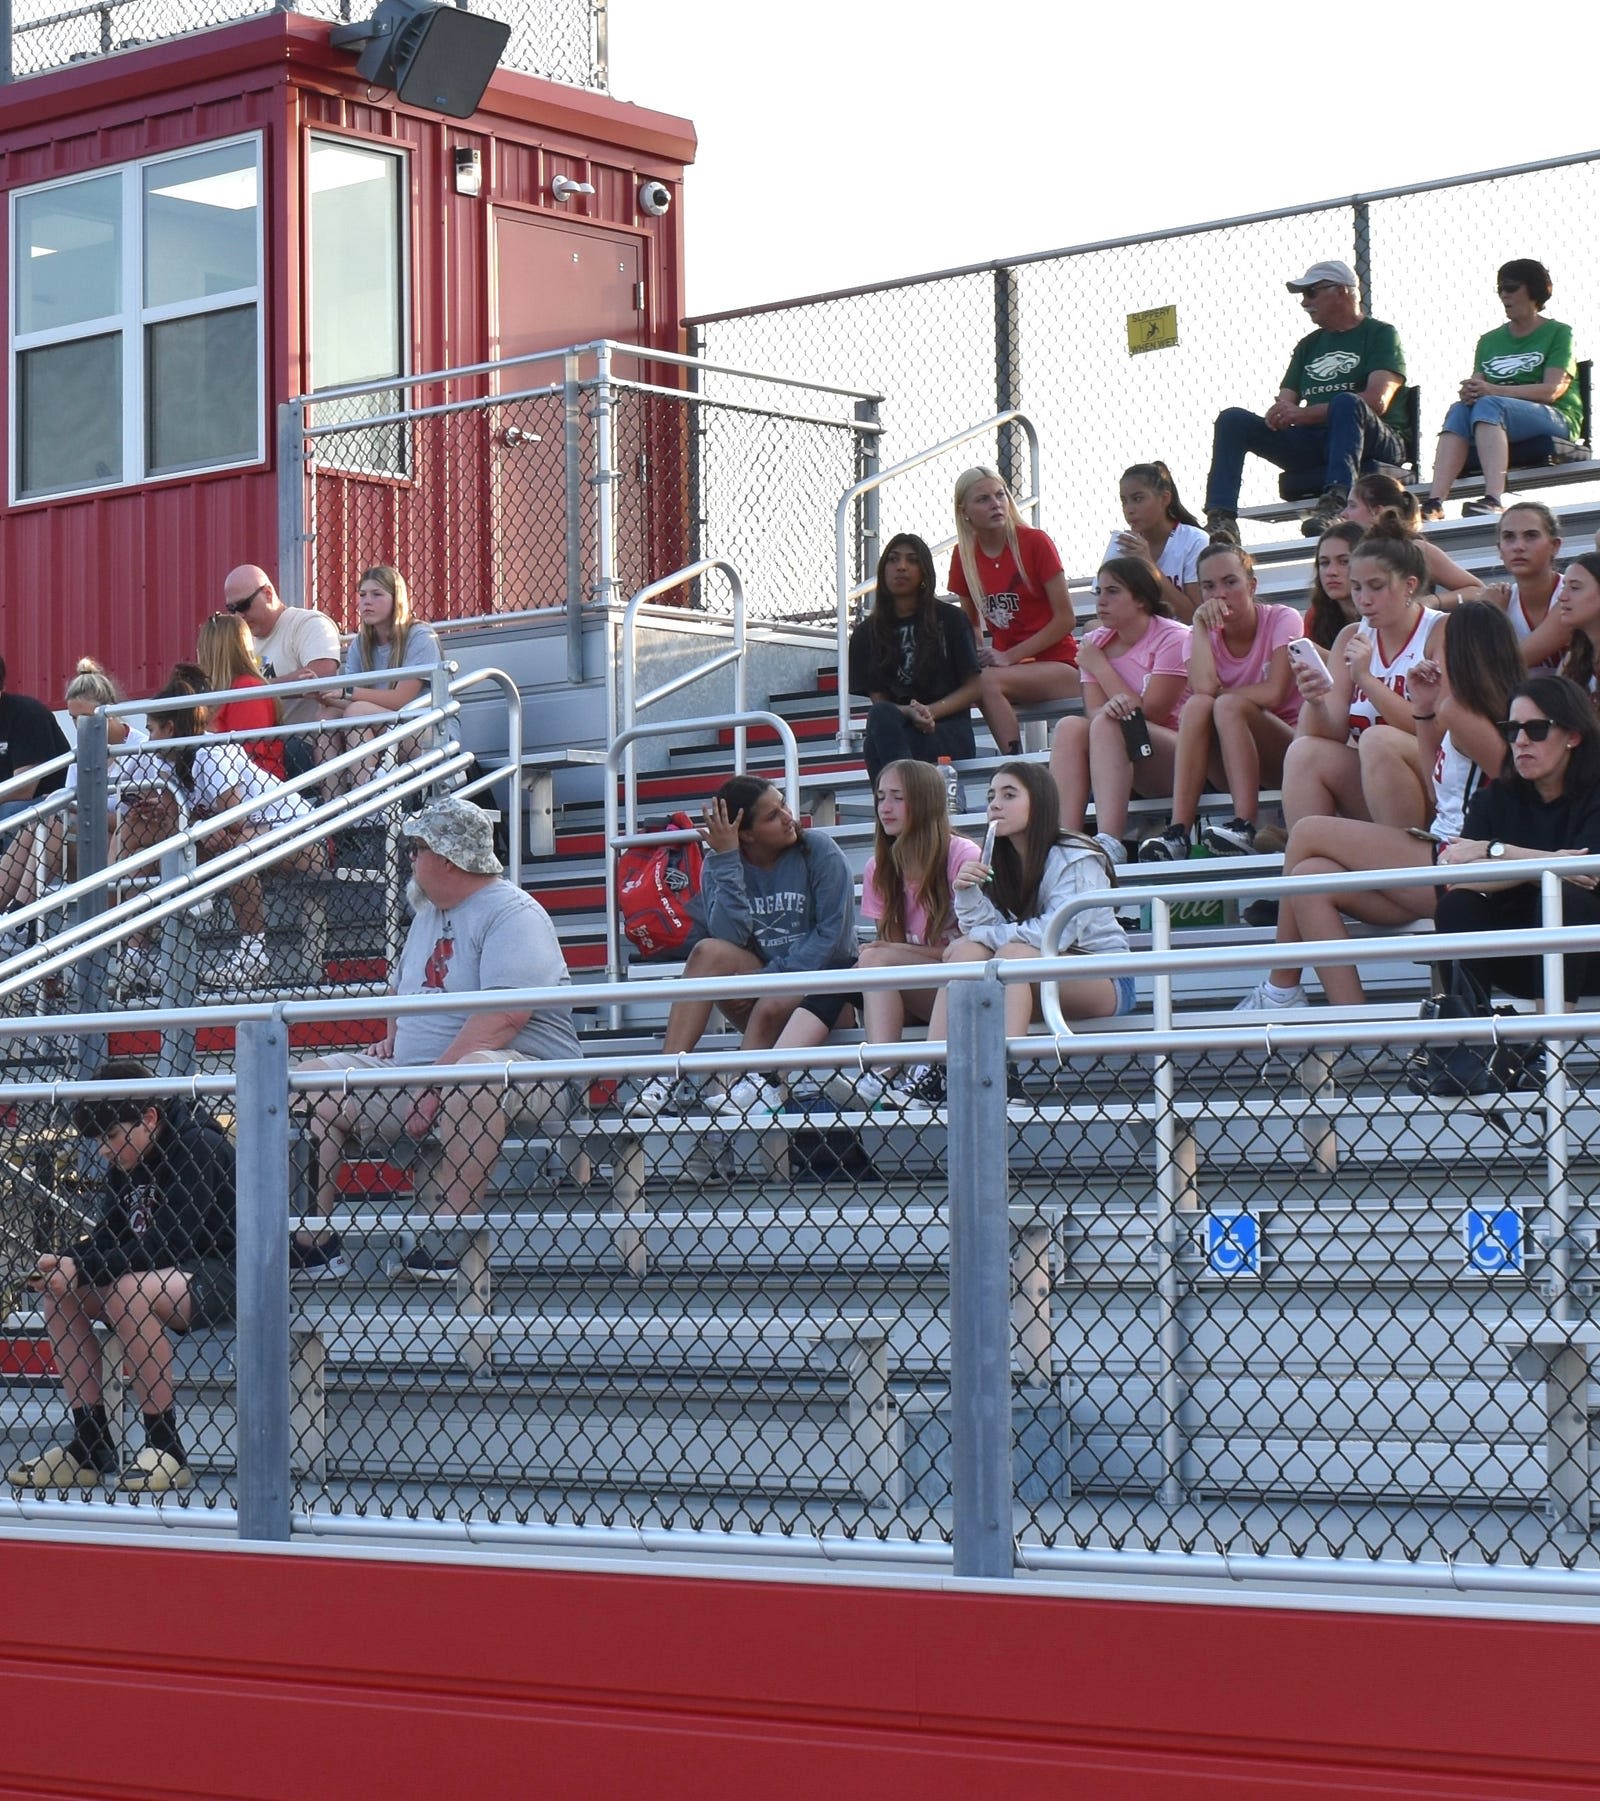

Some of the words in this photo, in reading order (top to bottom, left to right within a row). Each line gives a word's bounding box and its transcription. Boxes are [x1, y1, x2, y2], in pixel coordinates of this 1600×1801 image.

[1131, 306, 1170, 323] SLIPPERY
[1130, 341, 1155, 355] WHEN
[1155, 337, 1177, 350] WET
[654, 861, 663, 891] UNDER
[748, 891, 806, 915] ARGATE
